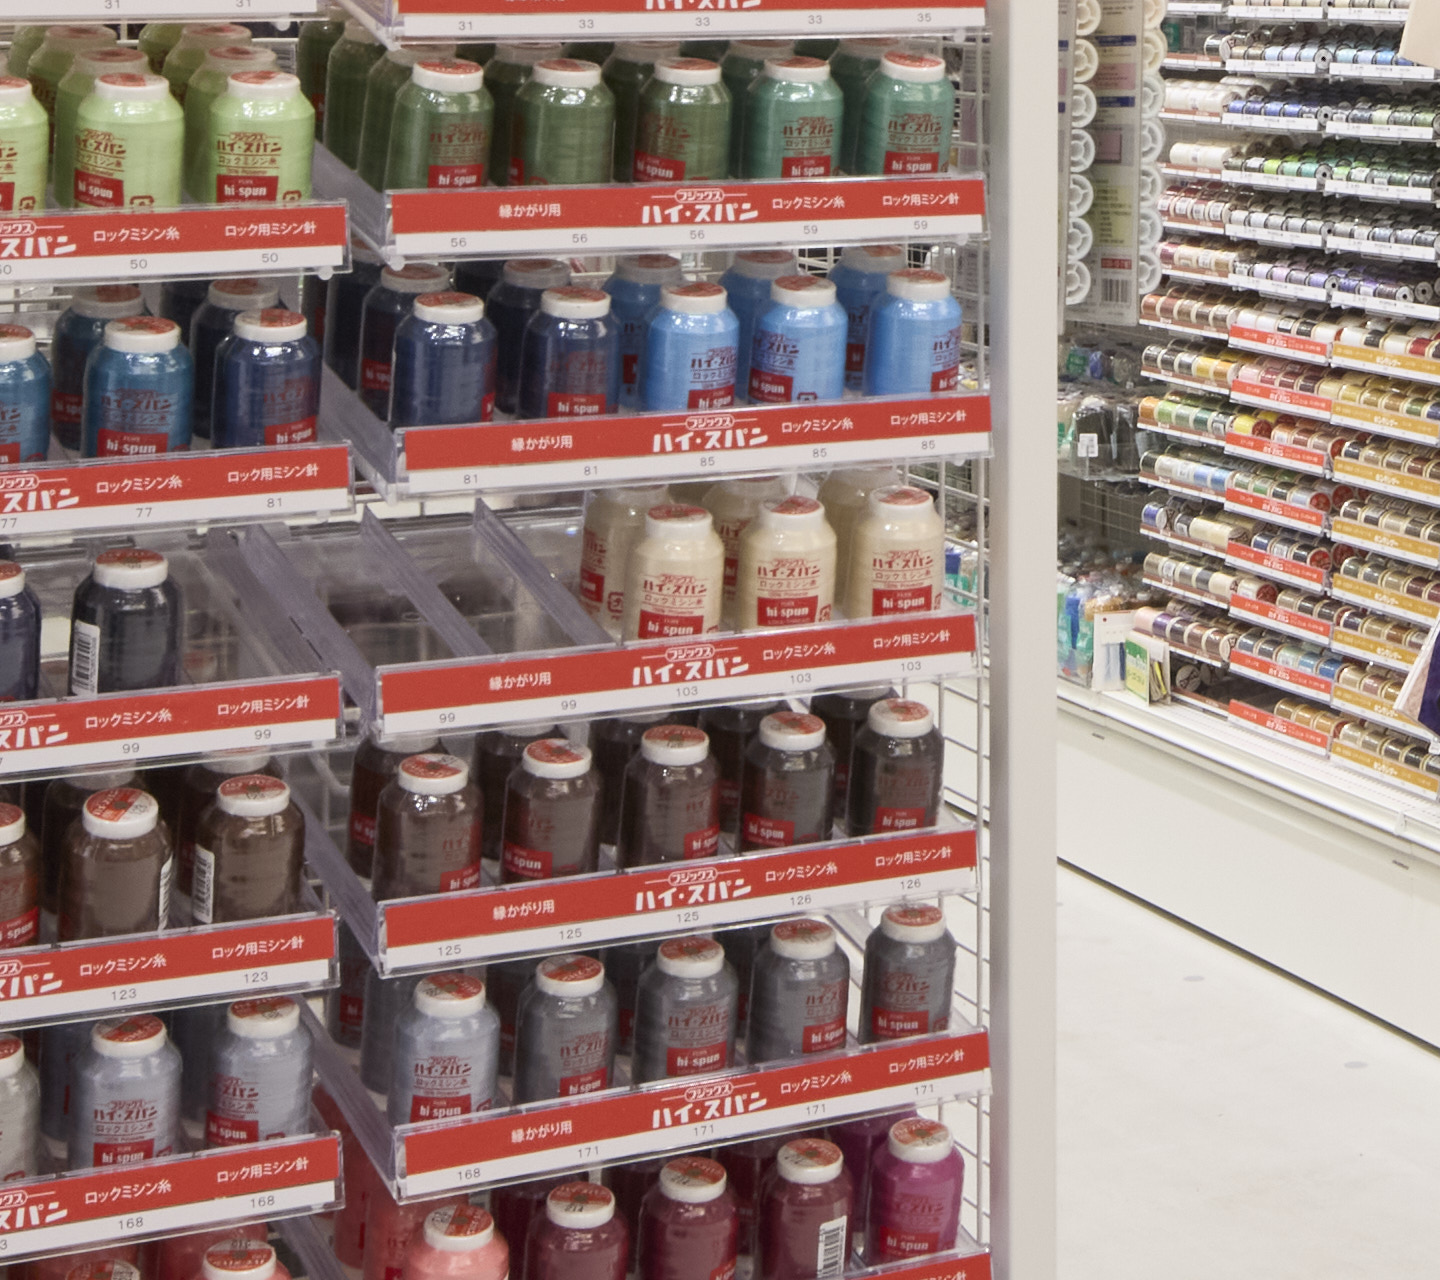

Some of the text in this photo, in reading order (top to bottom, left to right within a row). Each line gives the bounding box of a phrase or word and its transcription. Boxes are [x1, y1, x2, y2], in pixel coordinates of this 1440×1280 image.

[499, 193, 959, 223] 縁かがり用 ハイ・スパン ロックミシン糸 ロック用ミシン針
[451, 220, 928, 247] 56 59
[97, 475, 182, 493] ロックミシン糸
[228, 463, 318, 482] ロック用ミシン針
[267, 498, 281, 508] 81
[80, 954, 166, 976] ロックミシン糸
[212, 935, 304, 958] ロック用ミシン針
[244, 971, 268, 983] 123
